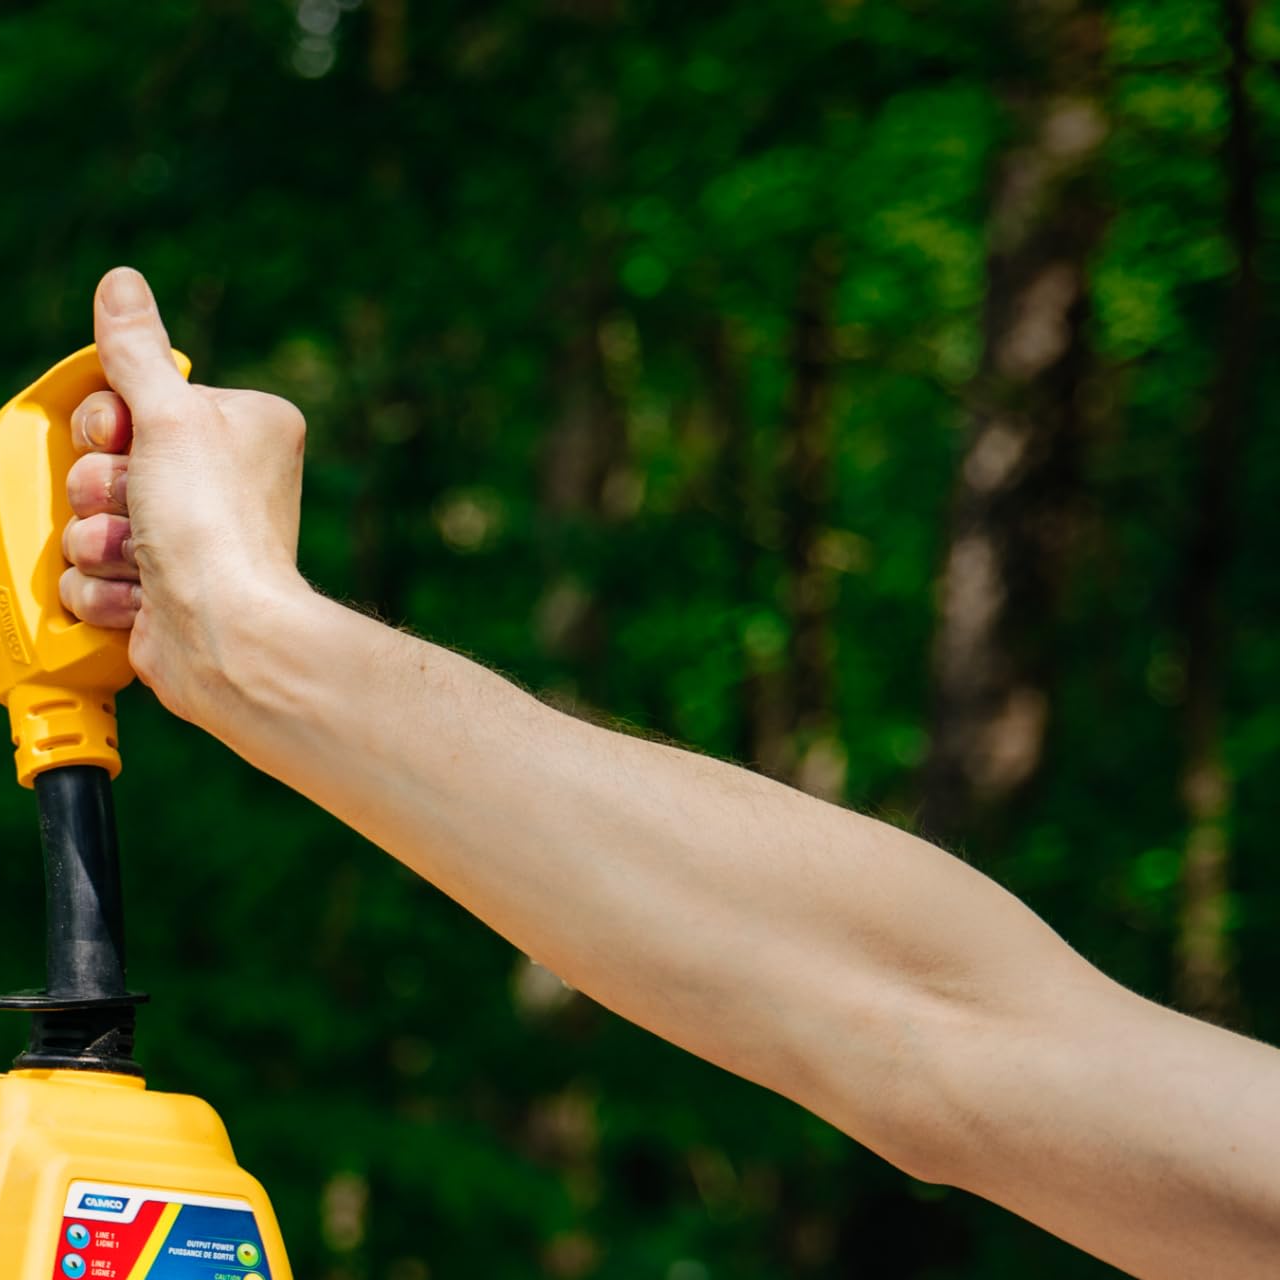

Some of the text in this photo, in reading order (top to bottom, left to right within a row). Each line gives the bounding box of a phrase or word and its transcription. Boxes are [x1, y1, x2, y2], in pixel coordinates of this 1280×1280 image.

[84, 1196, 124, 1211] CAMCO
[95, 1231, 110, 1239] LINE
[95, 1240, 120, 1249] LIGNE 1
[186, 1239, 235, 1252] OUTPUT POWER
[168, 1247, 235, 1261] PUISSANCE DE SORTIE
[91, 1259, 111, 1268] LINE 2
[91, 1268, 116, 1278] LIGNE 2
